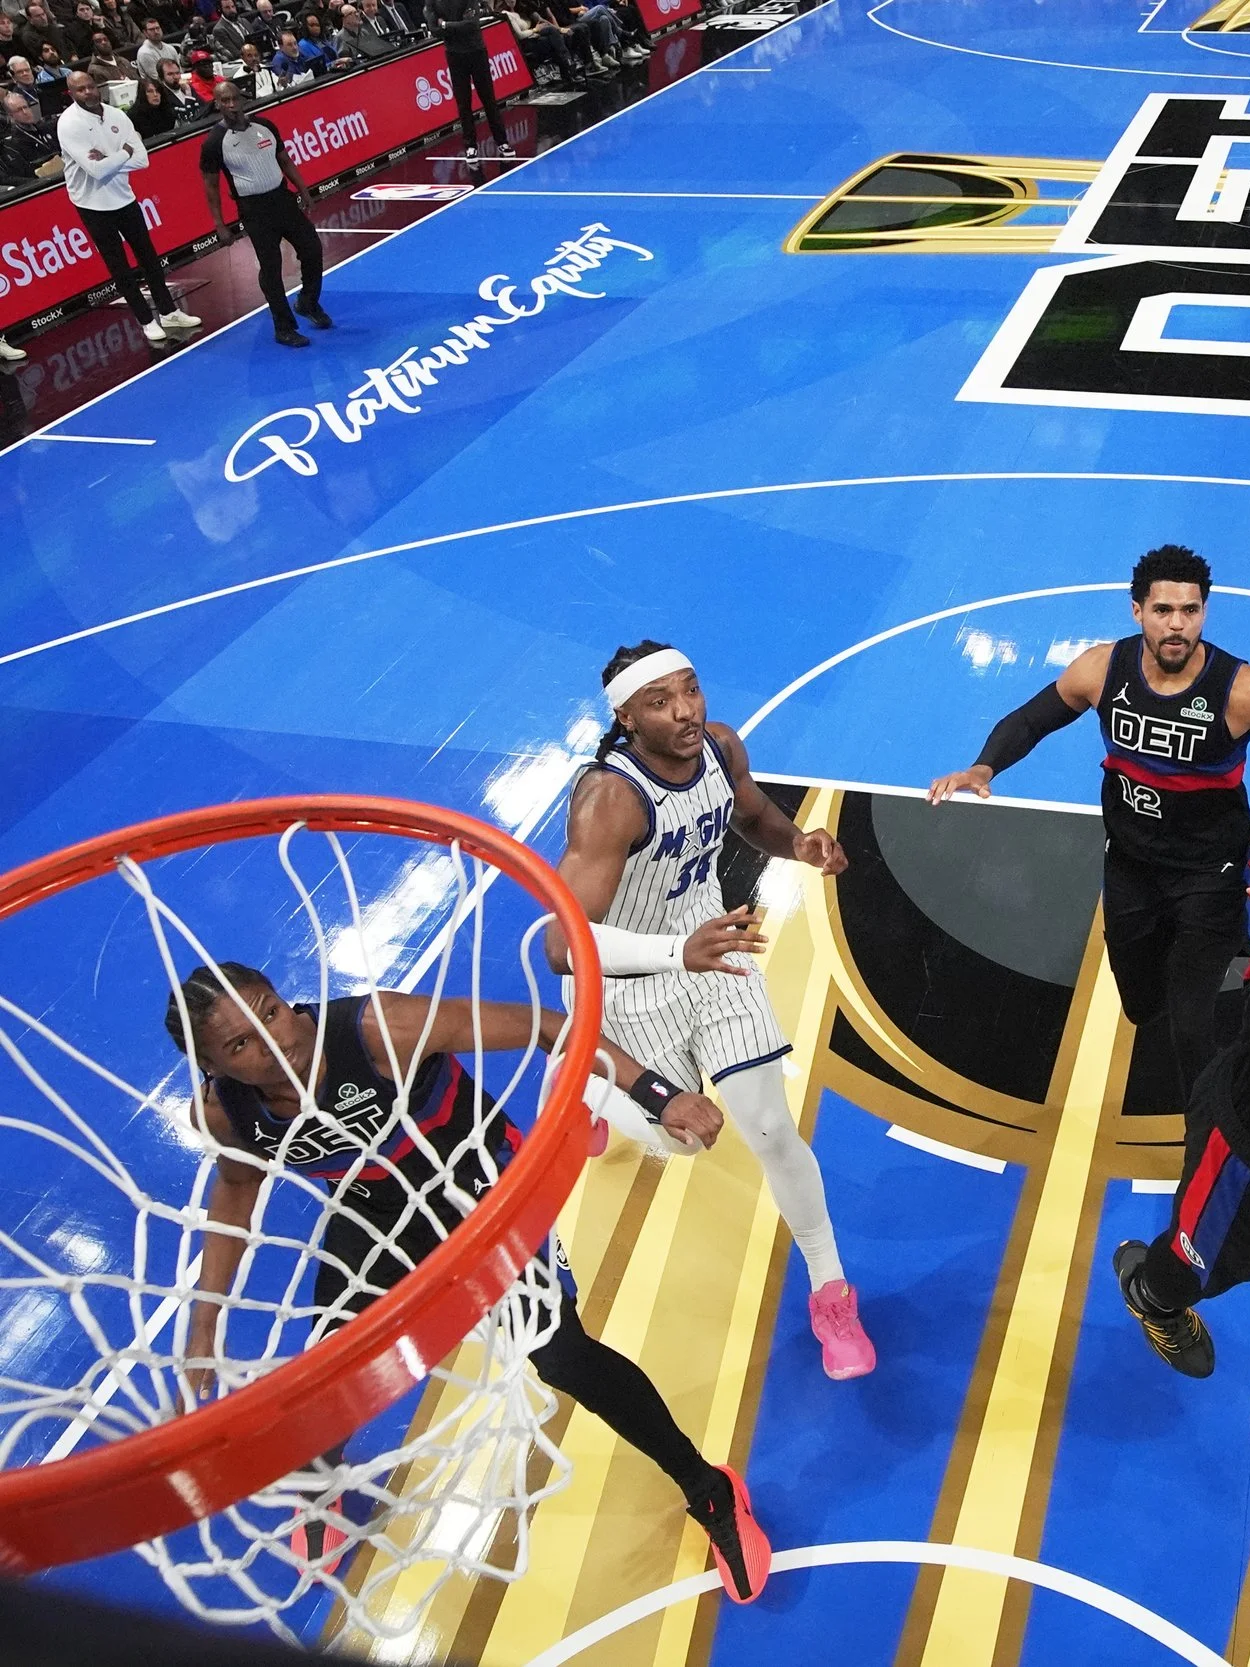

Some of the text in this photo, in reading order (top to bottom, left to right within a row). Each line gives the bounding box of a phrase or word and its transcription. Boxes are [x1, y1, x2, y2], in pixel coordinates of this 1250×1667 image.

[489, 50, 518, 82] arm
[388, 146, 407, 160] StockX
[355, 162, 375, 176] StockX
[318, 178, 340, 194] StockX
[192, 234, 218, 253] StockX
[87, 282, 117, 302] StockX
[31, 307, 63, 329] StockX
[225, 222, 654, 483] Platinum Equity
[1181, 708, 1213, 720] StockX
[1111, 707, 1207, 762] DET
[1118, 774, 1163, 819] 12
[651, 798, 734, 862] MGIC
[665, 848, 716, 901] 34
[336, 1088, 376, 1110] StockX
